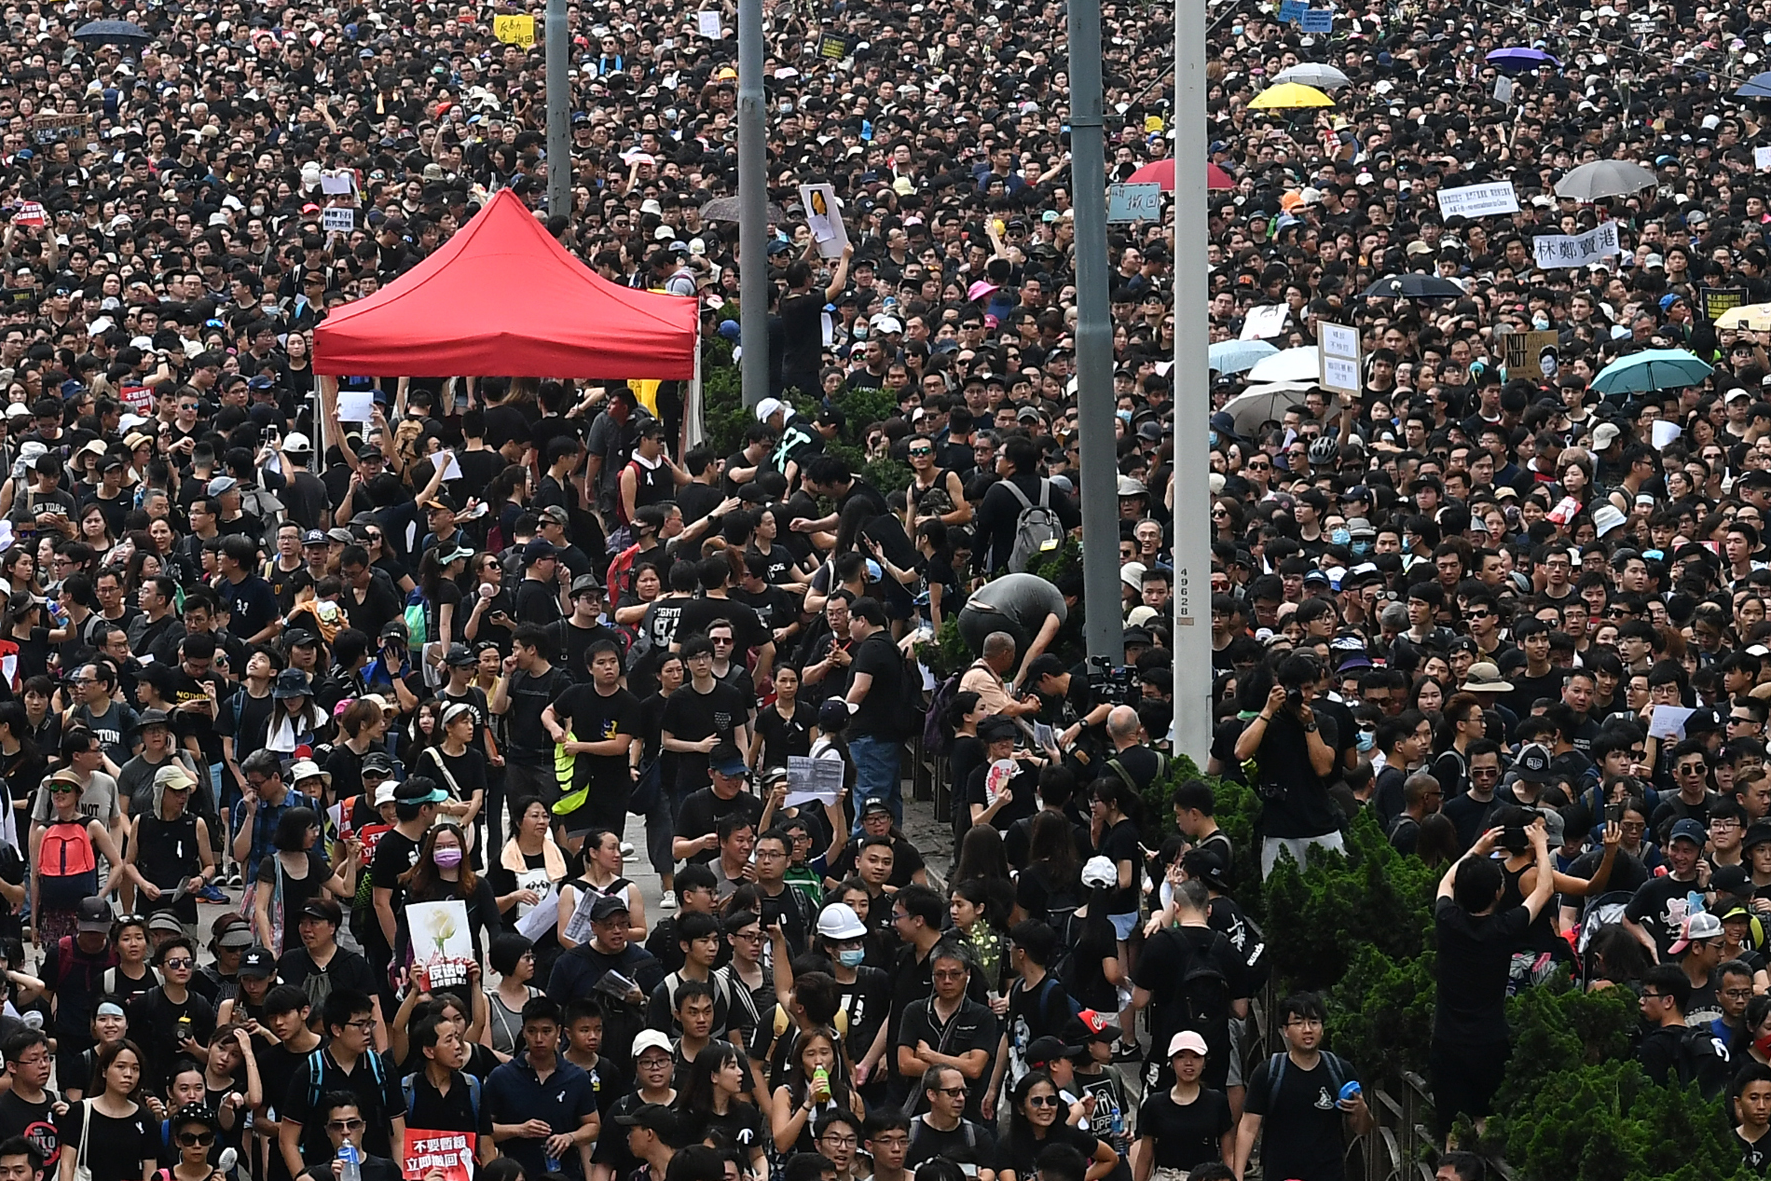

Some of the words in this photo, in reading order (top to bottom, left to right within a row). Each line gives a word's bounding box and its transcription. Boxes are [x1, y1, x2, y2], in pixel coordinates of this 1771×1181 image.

[1536, 227, 1615, 261] 林鄭賣港
[1507, 333, 1527, 350] NOT
[1507, 351, 1528, 368] NOT
[44, 502, 67, 513] YORK
[1180, 568, 1188, 616] 49628
[176, 690, 211, 701] NOTHIN
[428, 962, 467, 981] 反送中
[413, 1134, 466, 1154] 不要暫緩
[405, 1153, 458, 1172] 立即撤回
